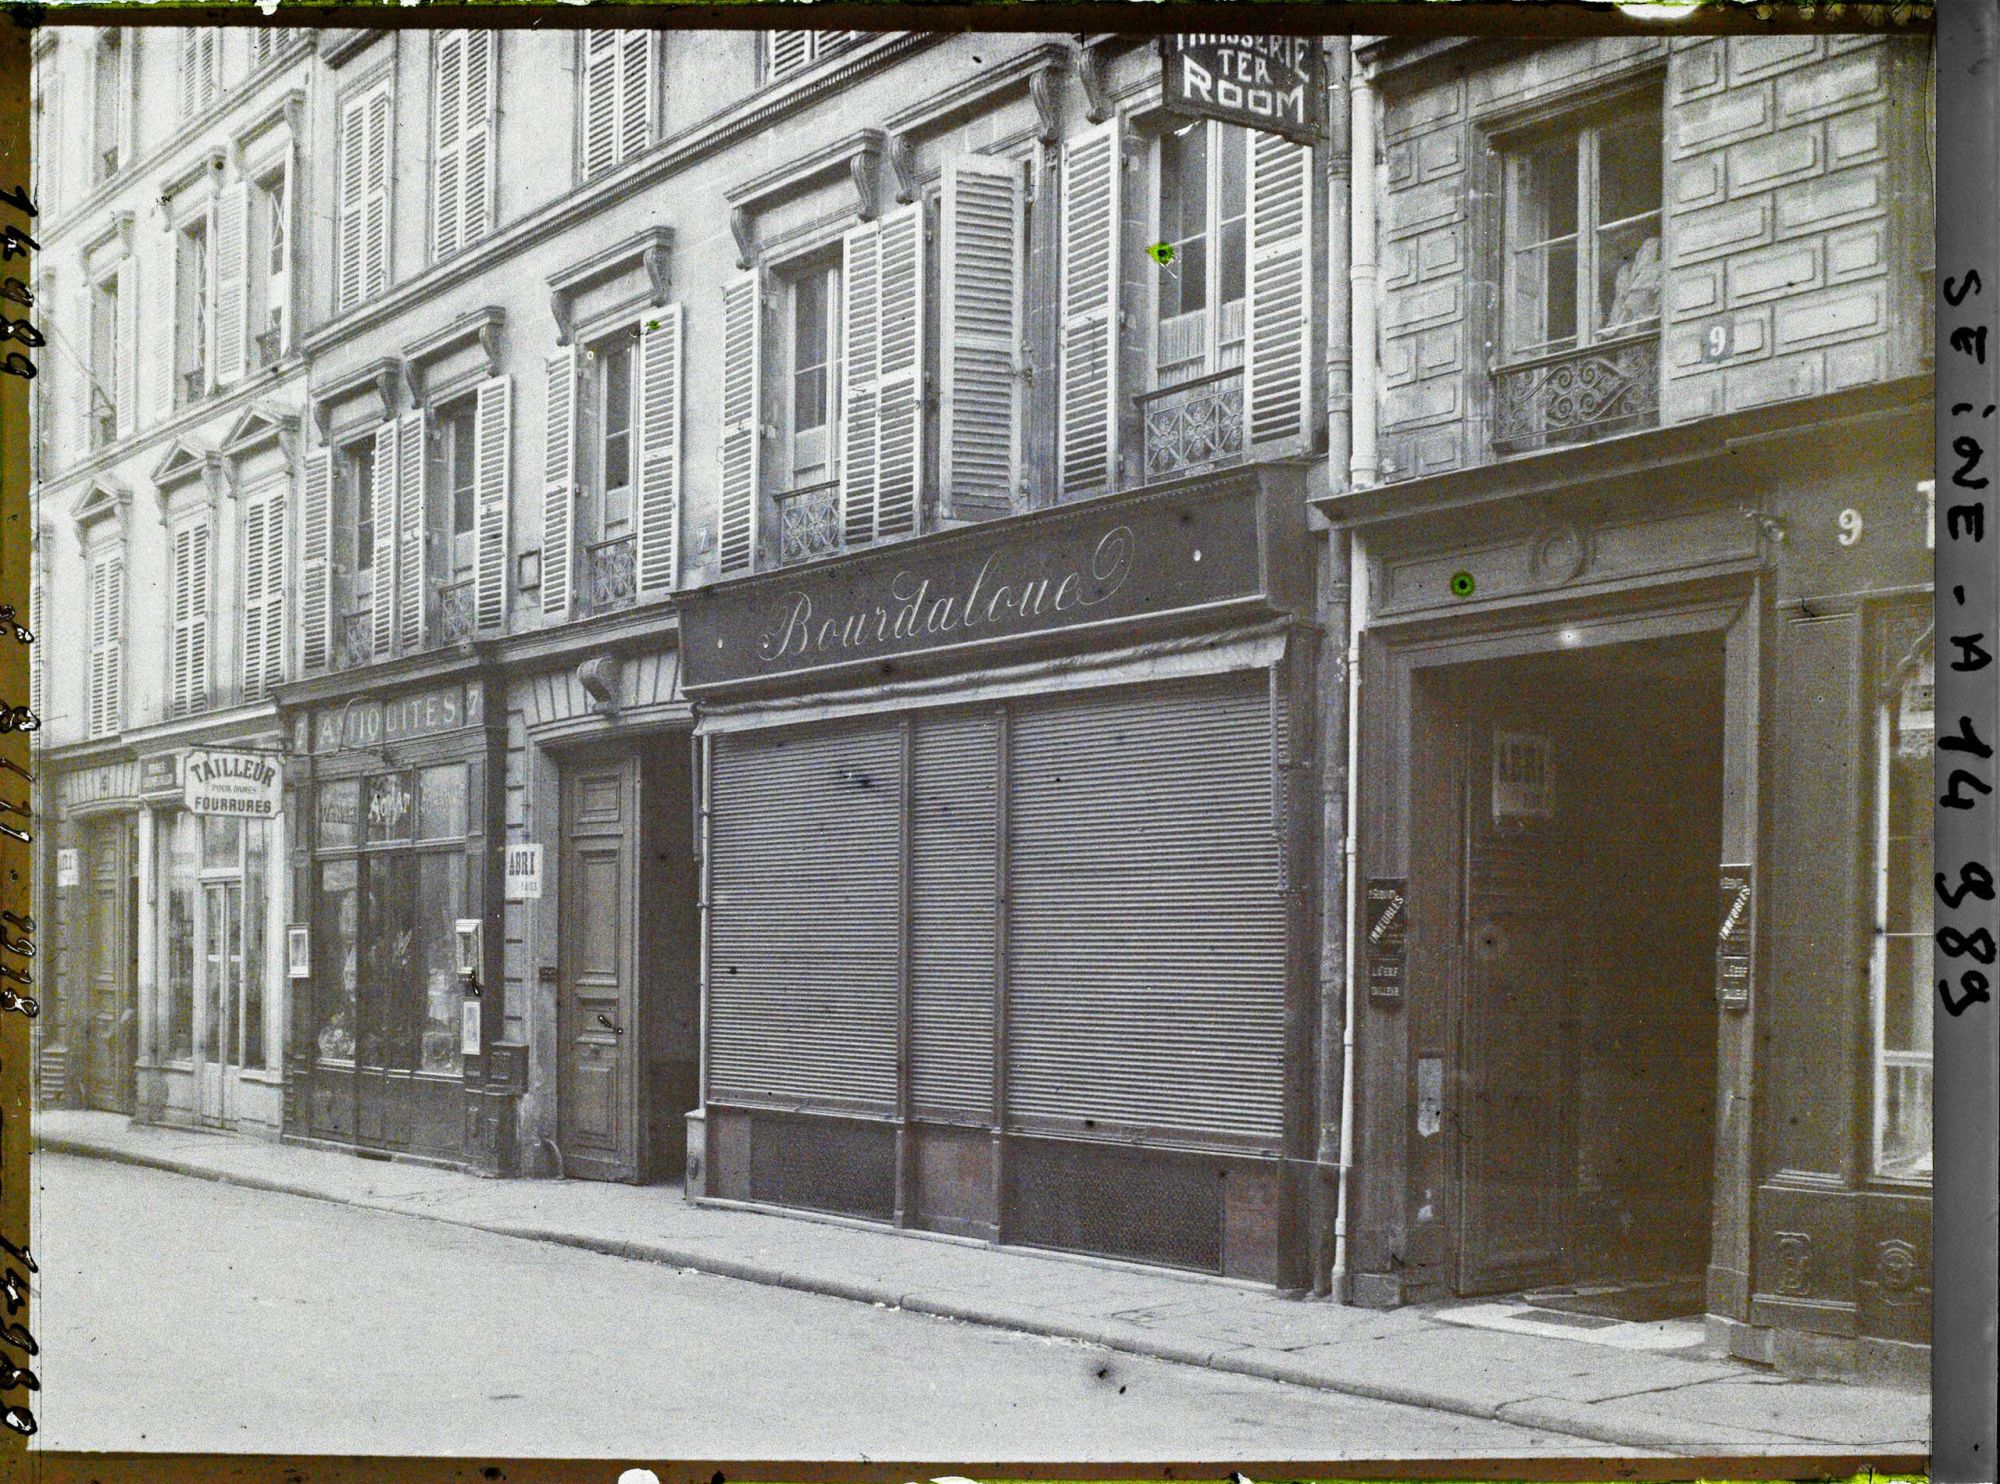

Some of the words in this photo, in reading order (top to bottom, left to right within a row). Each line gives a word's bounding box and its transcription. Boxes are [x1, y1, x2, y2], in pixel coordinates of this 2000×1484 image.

[1183, 54, 1304, 124] ROOM
[1708, 325, 1728, 357] 9
[1837, 507, 1863, 547] 9
[757, 526, 1135, 661] Bourdaloue
[468, 689, 481, 717] 7
[190, 758, 276, 788] TAILLEUR
[194, 796, 272, 814] FOURRURES
[508, 851, 536, 876] ABRI
